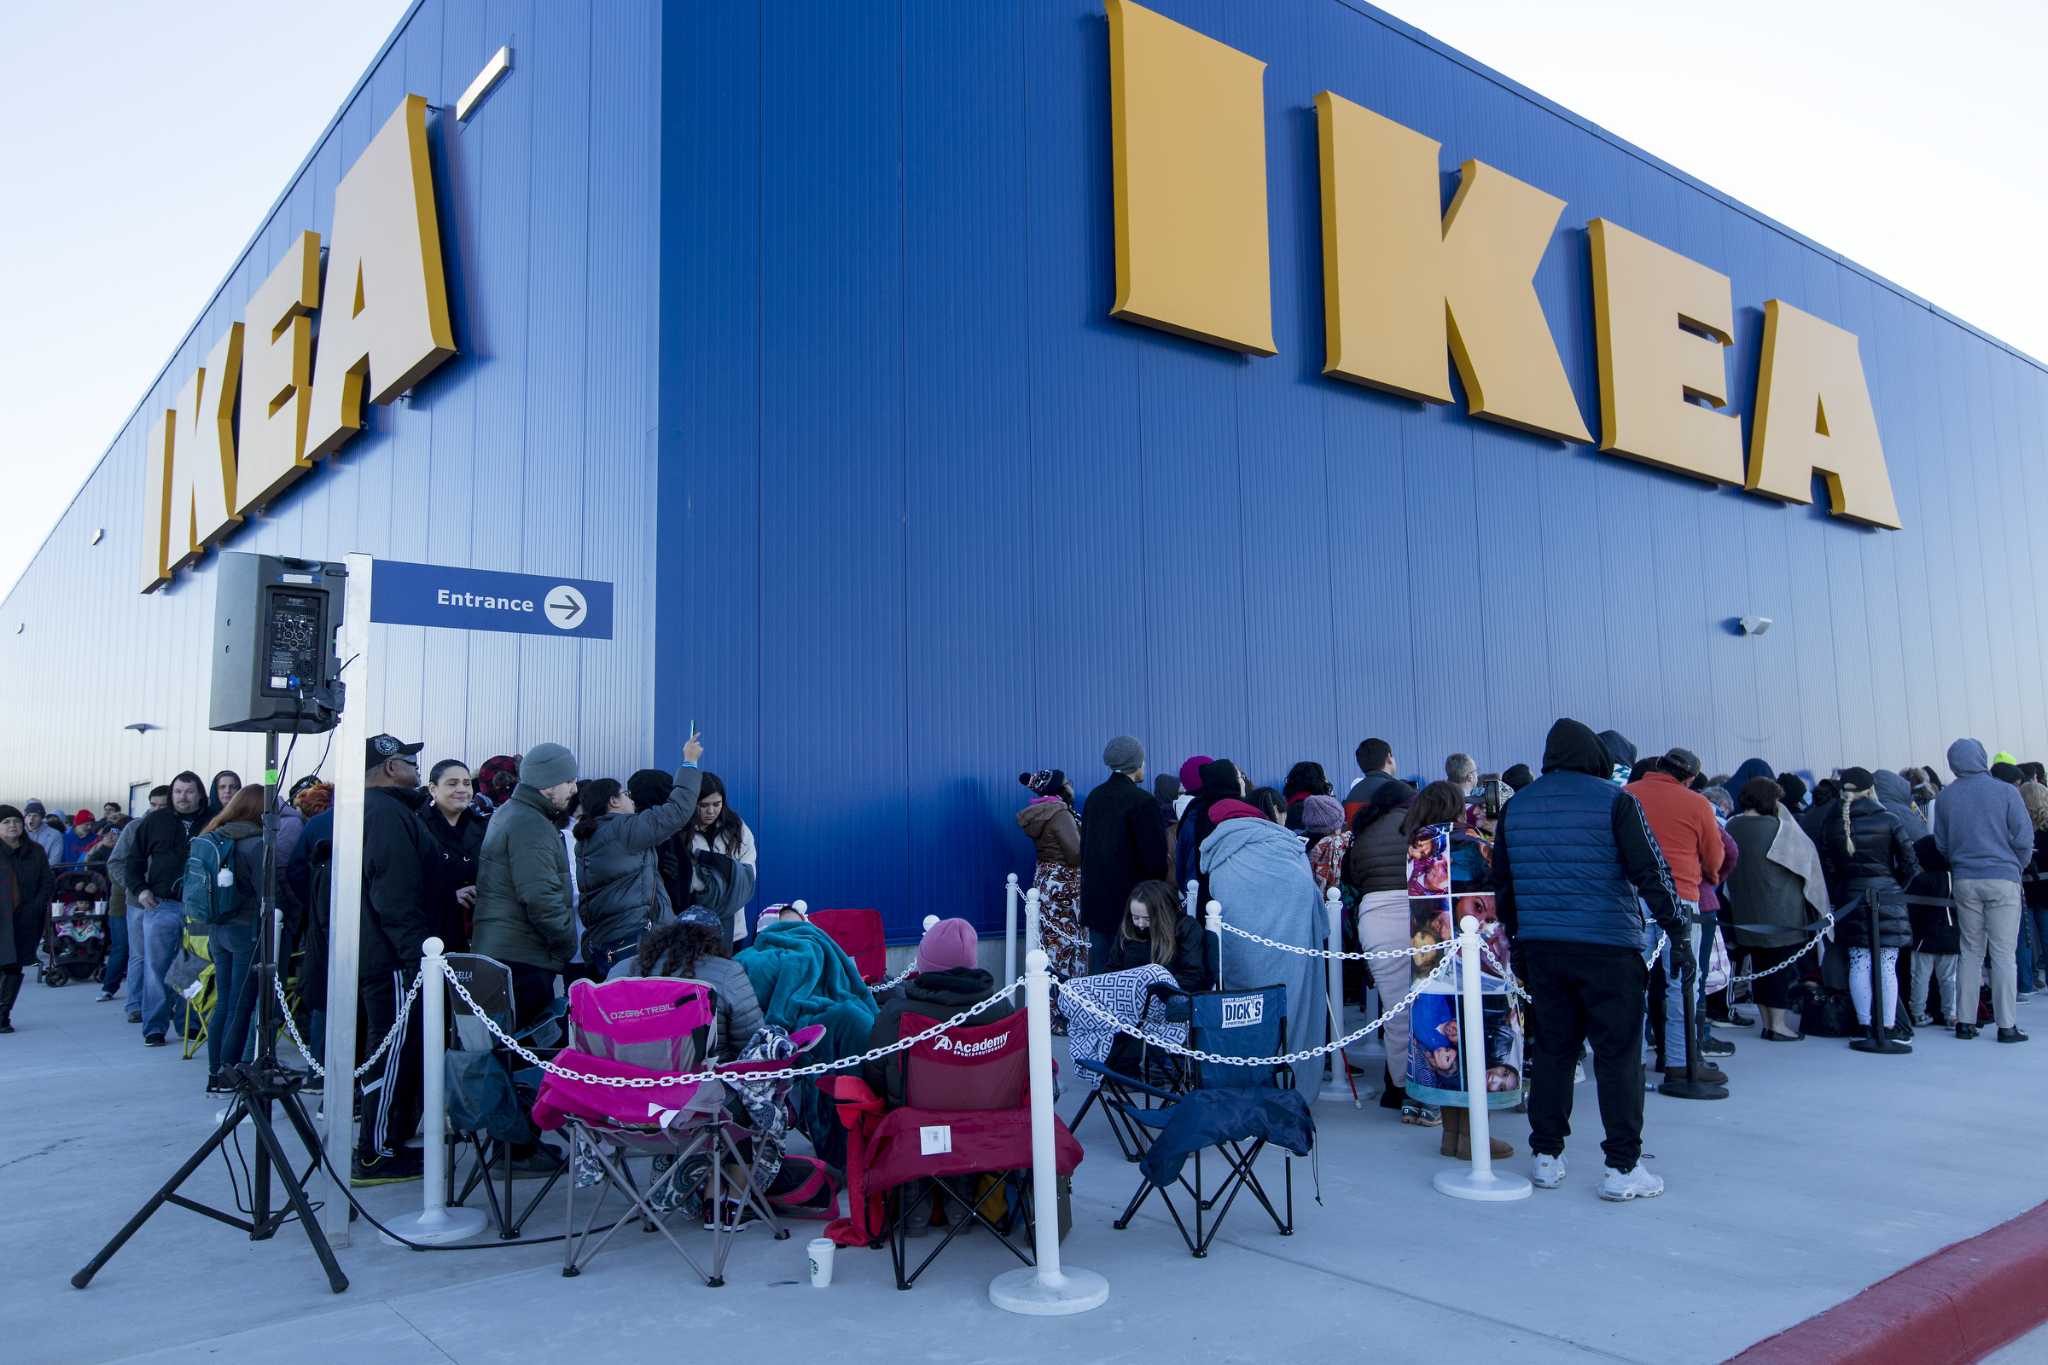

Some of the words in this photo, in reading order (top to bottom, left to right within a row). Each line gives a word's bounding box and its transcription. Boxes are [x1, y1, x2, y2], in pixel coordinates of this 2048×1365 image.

[141, 93, 457, 594] IKEA
[1104, 0, 1903, 530] IKEA
[437, 588, 534, 612] Entrance
[954, 1032, 1008, 1053] Academy
